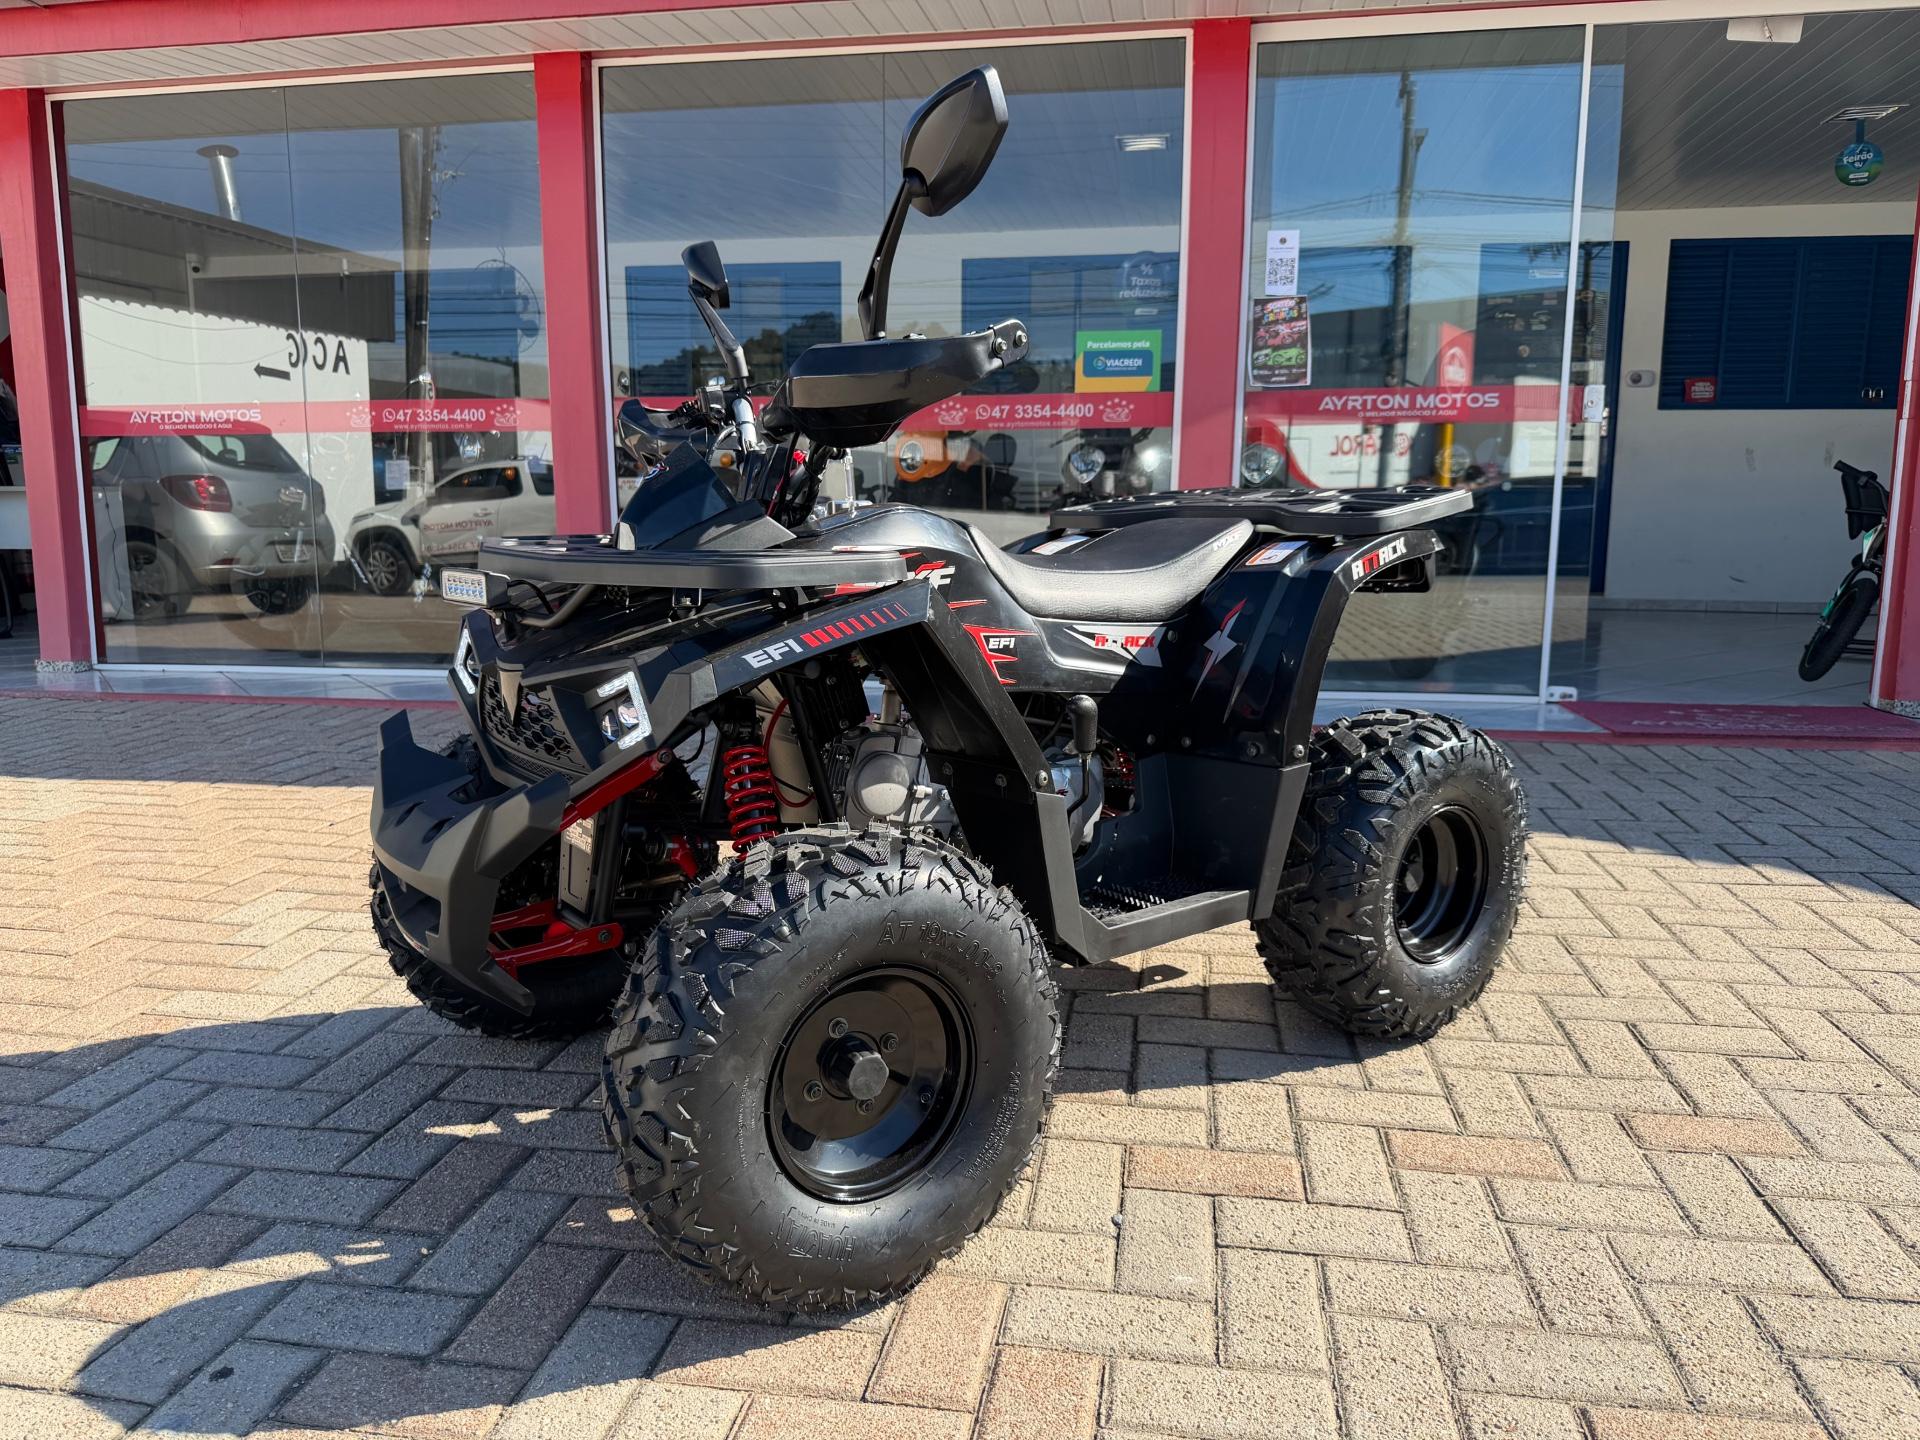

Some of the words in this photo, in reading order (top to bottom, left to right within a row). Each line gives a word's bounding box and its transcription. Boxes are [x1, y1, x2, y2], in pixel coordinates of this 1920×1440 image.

[1843, 151, 1874, 164] Feirão
[1133, 340, 1150, 349] pela
[1106, 358, 1142, 366] VIACREDI
[1318, 394, 1409, 411] AYRTON
[1416, 393, 1500, 408] MOTOS
[130, 410, 196, 423] AYRTON
[201, 409, 262, 421] MOTOS
[396, 409, 410, 421] 47
[417, 408, 486, 422] 3354-4400
[992, 406, 1009, 418] 47
[1015, 404, 1094, 418] 3354-4400
[1351, 536, 1407, 581] ATTACK
[988, 636, 1015, 649] EFI
[1094, 635, 1156, 649] ATTACK
[742, 638, 804, 669] EFI
[879, 921, 914, 946] AT
